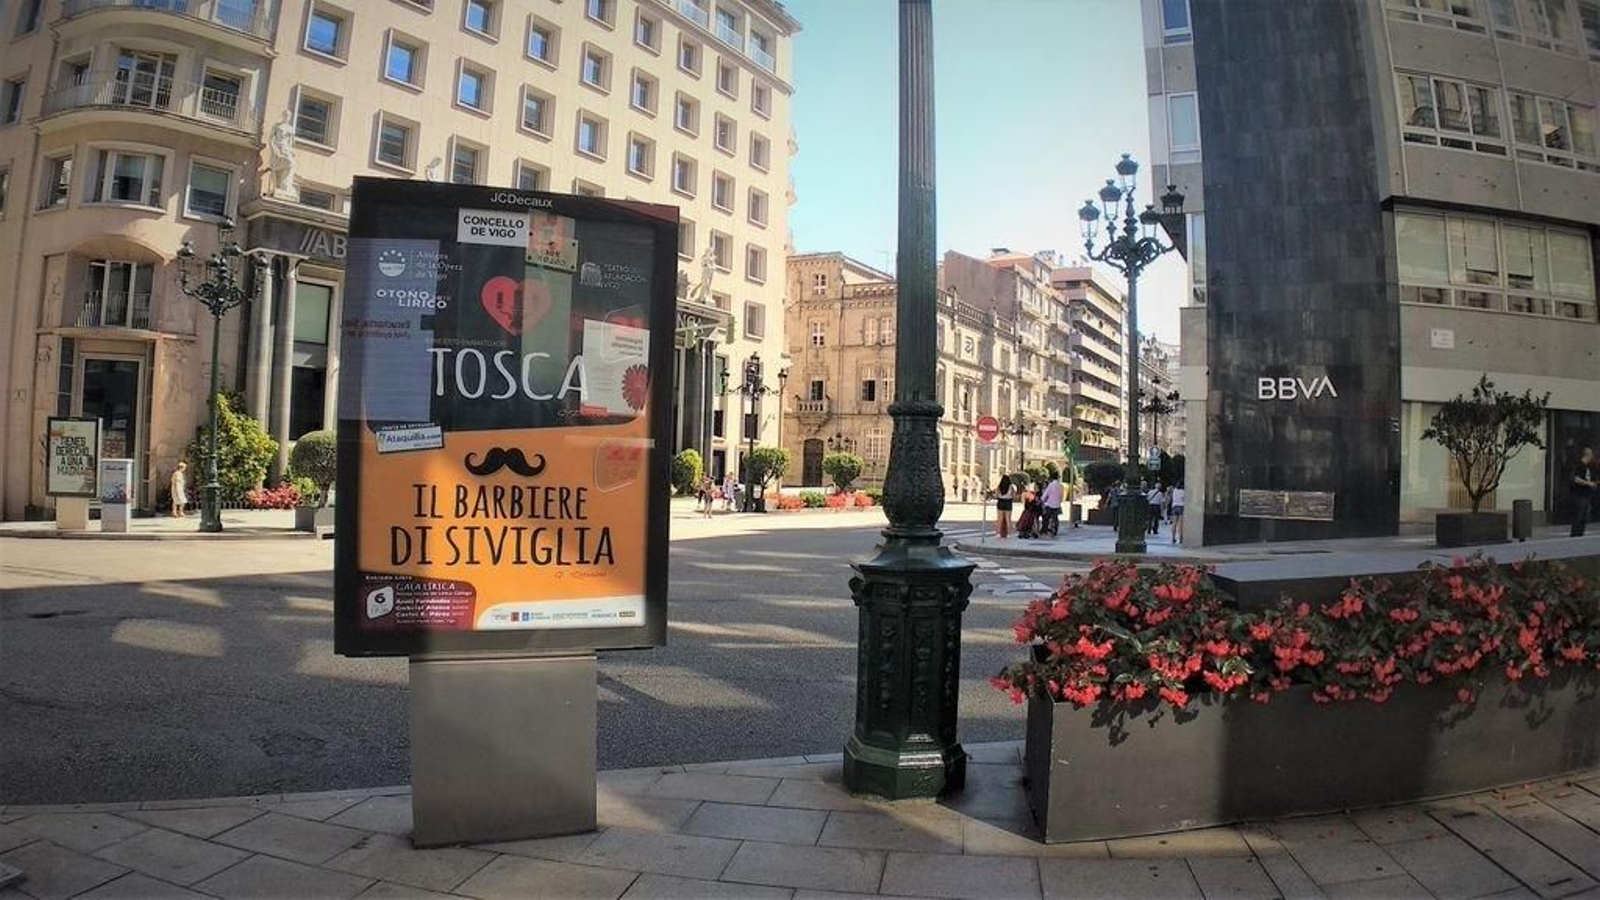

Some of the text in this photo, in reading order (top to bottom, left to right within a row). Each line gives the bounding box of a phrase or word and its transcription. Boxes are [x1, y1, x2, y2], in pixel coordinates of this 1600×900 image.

[490, 192, 553, 208] JCDecaux
[463, 215, 524, 229] CONCELLO
[470, 226, 517, 238] DE VIGO
[426, 347, 588, 401] TOSCA
[1258, 375, 1338, 400] BBVA
[56, 446, 89, 456] DERECHO
[412, 484, 588, 520] IL BARBIERE
[390, 525, 615, 566] DI SIVIGLIA
[395, 582, 421, 590] GALA
[374, 592, 387, 604] 6
